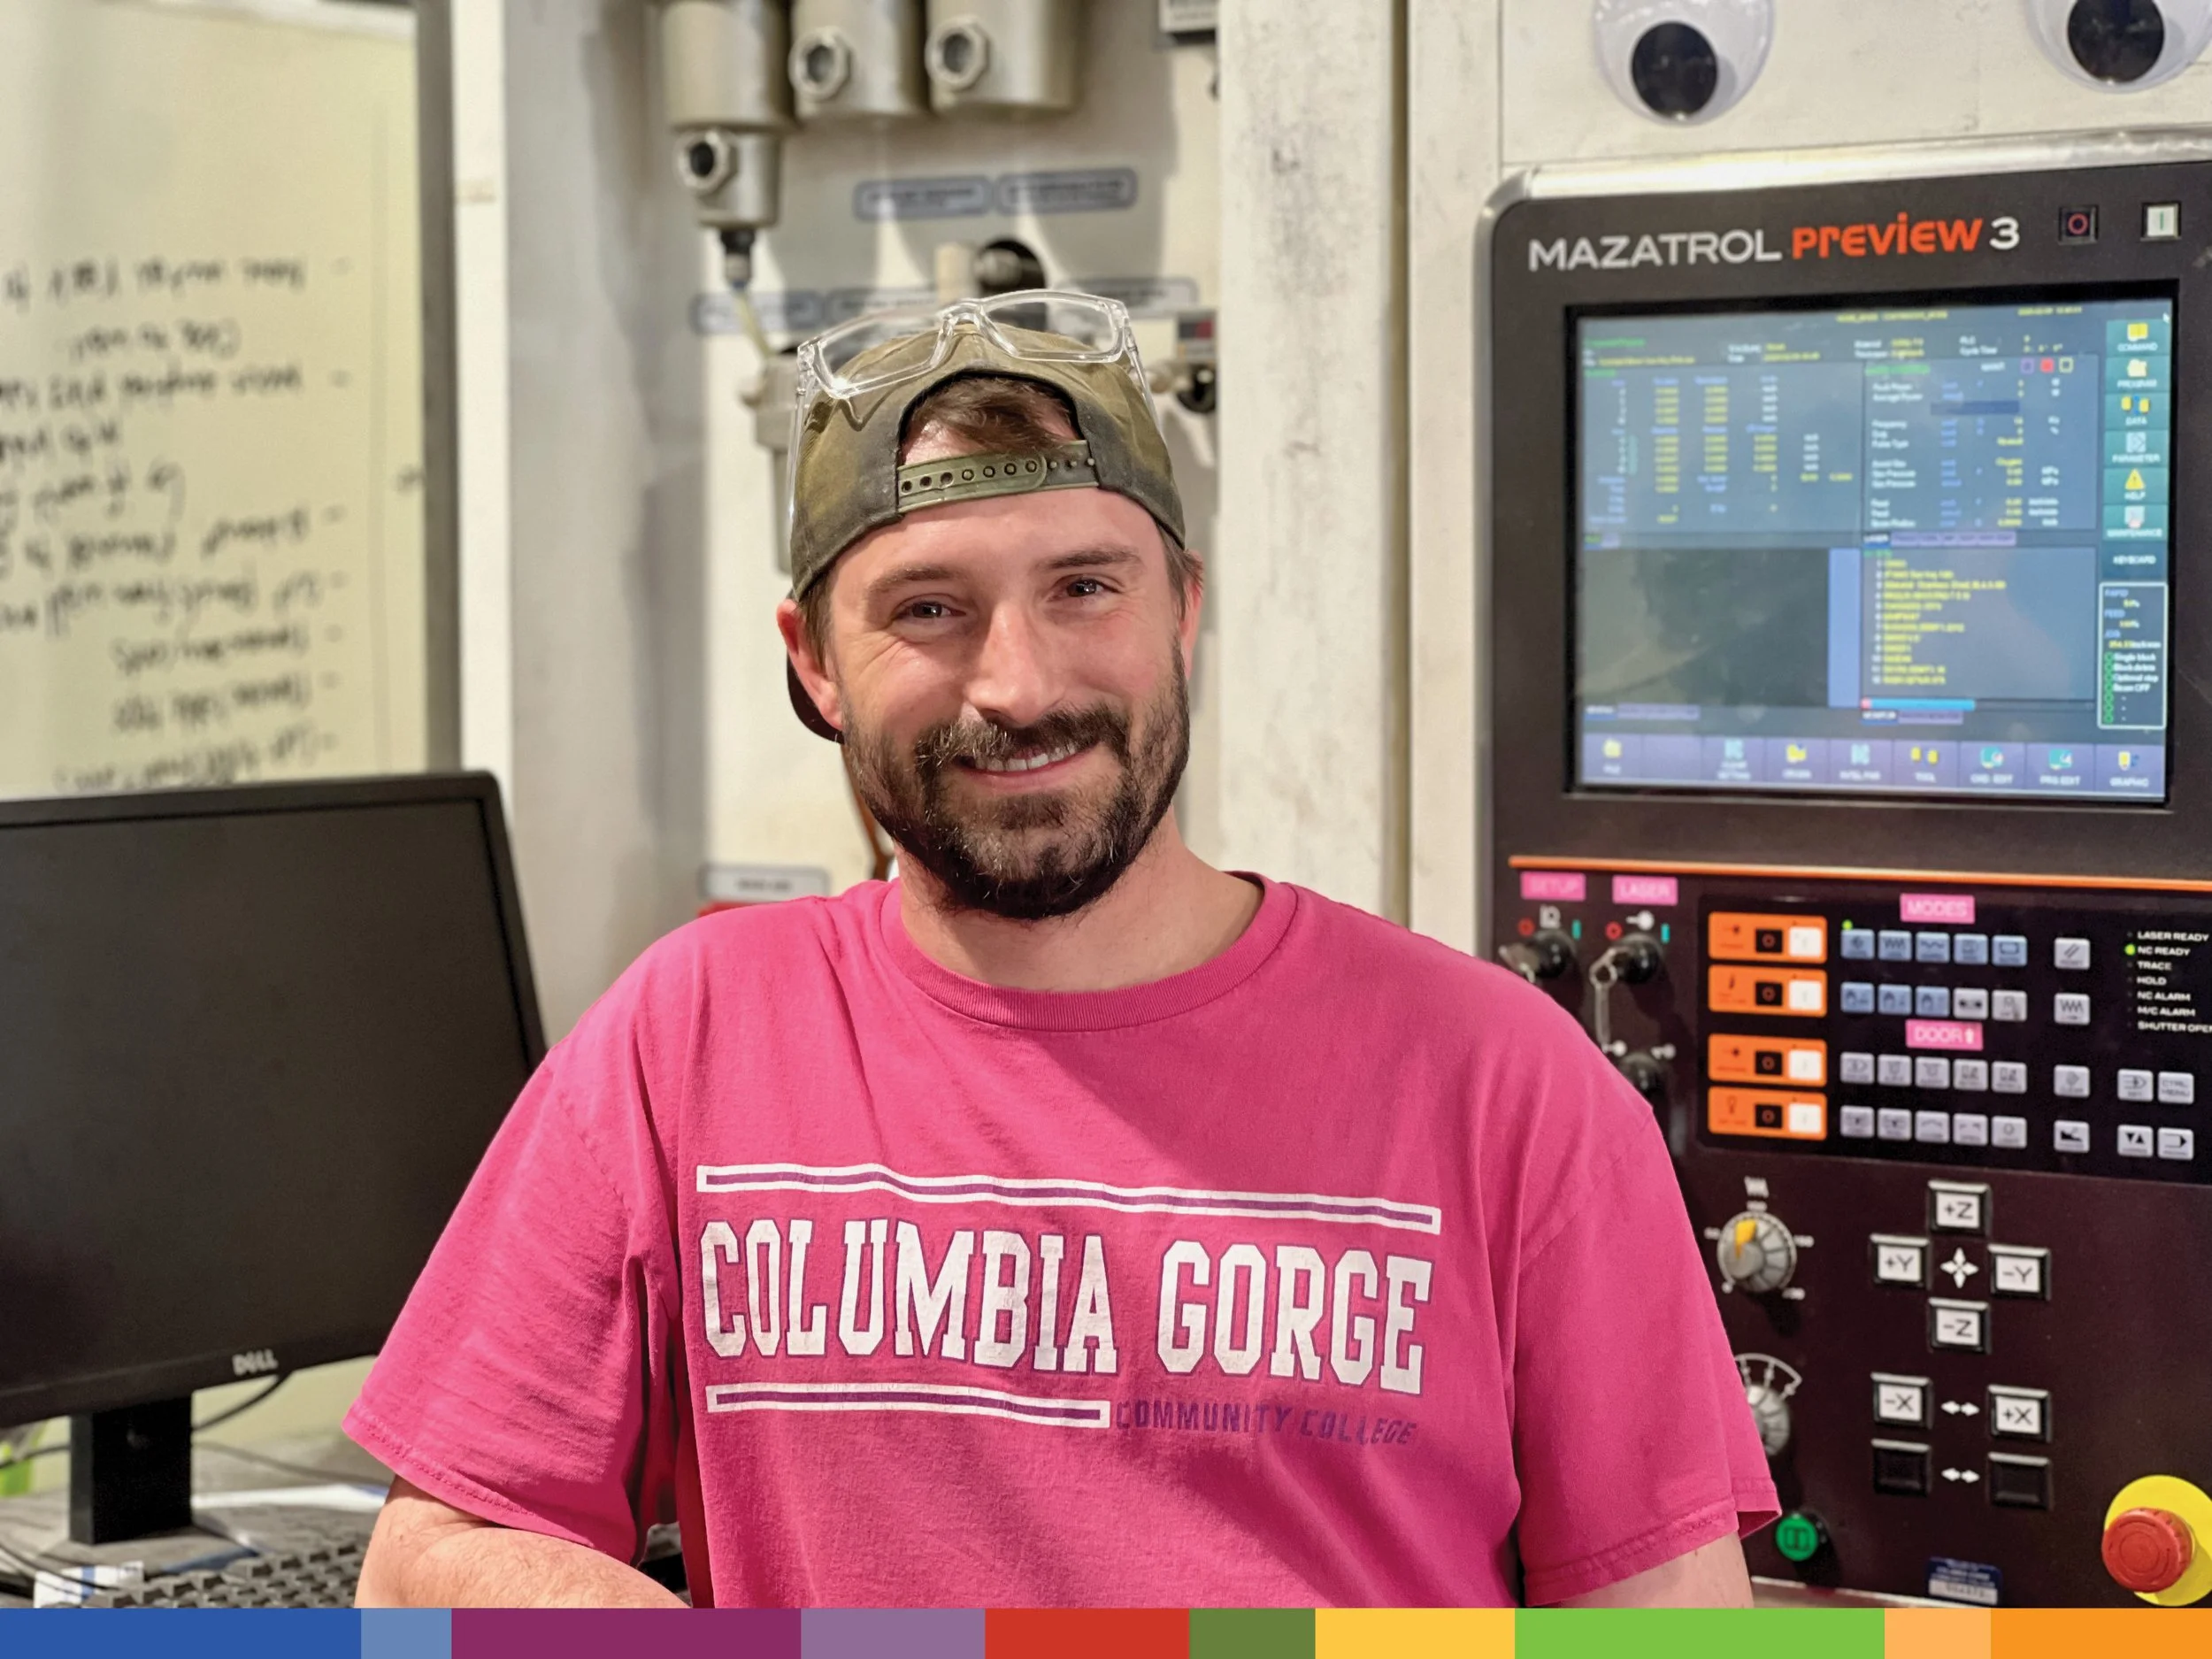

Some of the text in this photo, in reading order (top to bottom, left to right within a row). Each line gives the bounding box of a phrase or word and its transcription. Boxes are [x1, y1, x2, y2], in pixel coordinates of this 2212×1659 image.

[1528, 229, 1782, 271] MAZATROL
[1989, 216, 2020, 250] 3
[1530, 879, 1578, 895] SETUP
[1619, 880, 1671, 897] LASER
[1906, 900, 1968, 918] MODES
[2137, 930, 2209, 942] LASER READY
[2137, 946, 2191, 956] NC READY
[2137, 960, 2173, 972] TRACE
[2136, 976, 2167, 986] HOLD
[2137, 991, 2191, 1002] NC ALARM
[2137, 1006, 2197, 1017] M/C ALARM
[1915, 1025, 1962, 1043] DOOR
[2138, 1020, 2186, 1032] SHUTTER
[1944, 1201, 1974, 1219] +Z
[1885, 1254, 1914, 1271] +Y
[2002, 1265, 2032, 1284] -Y
[699, 1217, 1433, 1395] COLUMBIA GORGE
[1944, 1318, 1973, 1338] -Z
[232, 1348, 280, 1376] DELL
[1885, 1393, 1913, 1412] -X
[1117, 1399, 1417, 1446] COMMUNITY COLLEGE
[2002, 1407, 2032, 1425] +X
